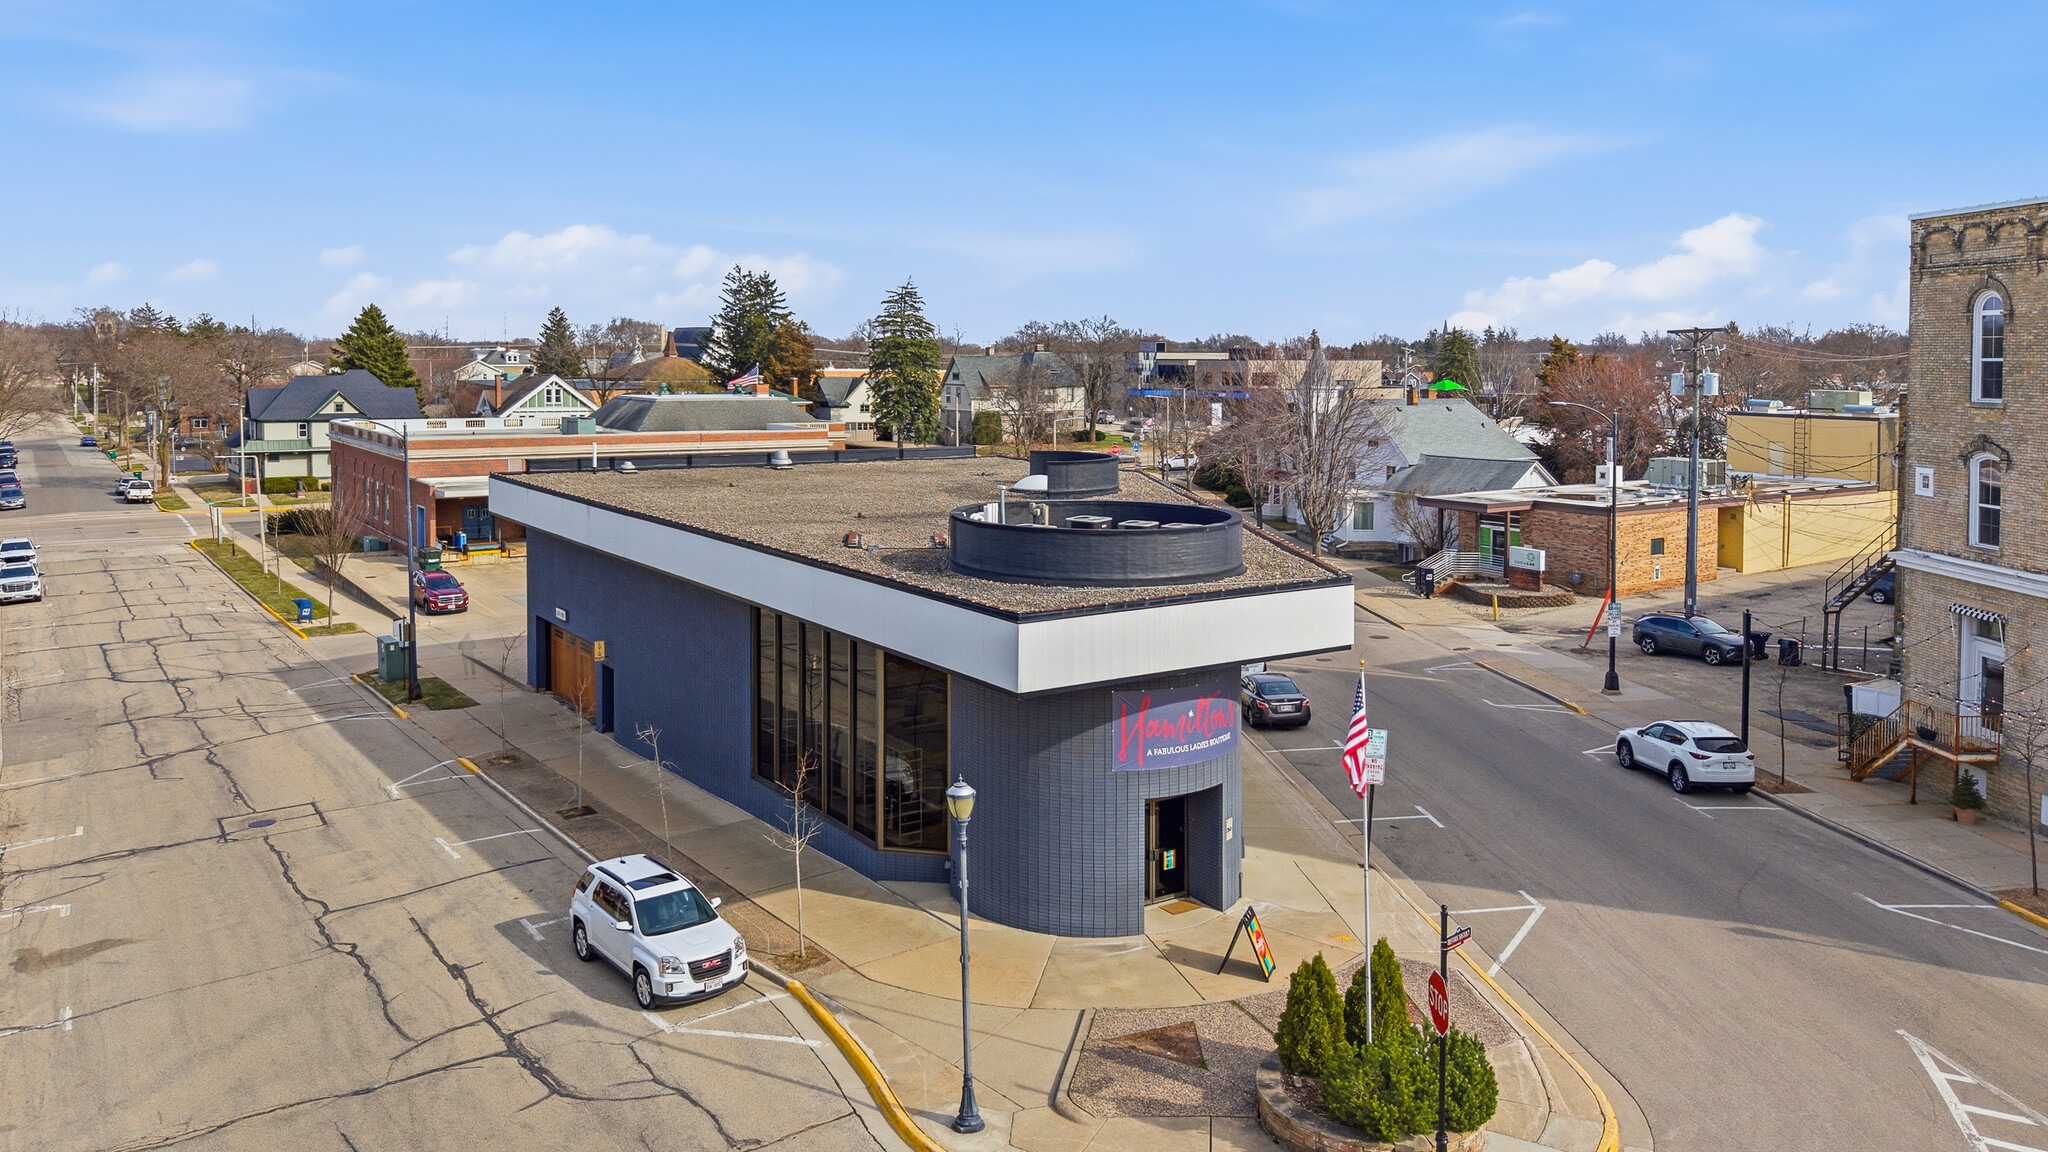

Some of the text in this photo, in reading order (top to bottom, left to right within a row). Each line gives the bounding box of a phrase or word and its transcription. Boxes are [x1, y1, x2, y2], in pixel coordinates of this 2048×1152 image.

[1146, 732, 1231, 757] A FABULOUS LADIES BOUTIQUE
[702, 959, 722, 969] GMC
[1429, 984, 1448, 1020] STOP
